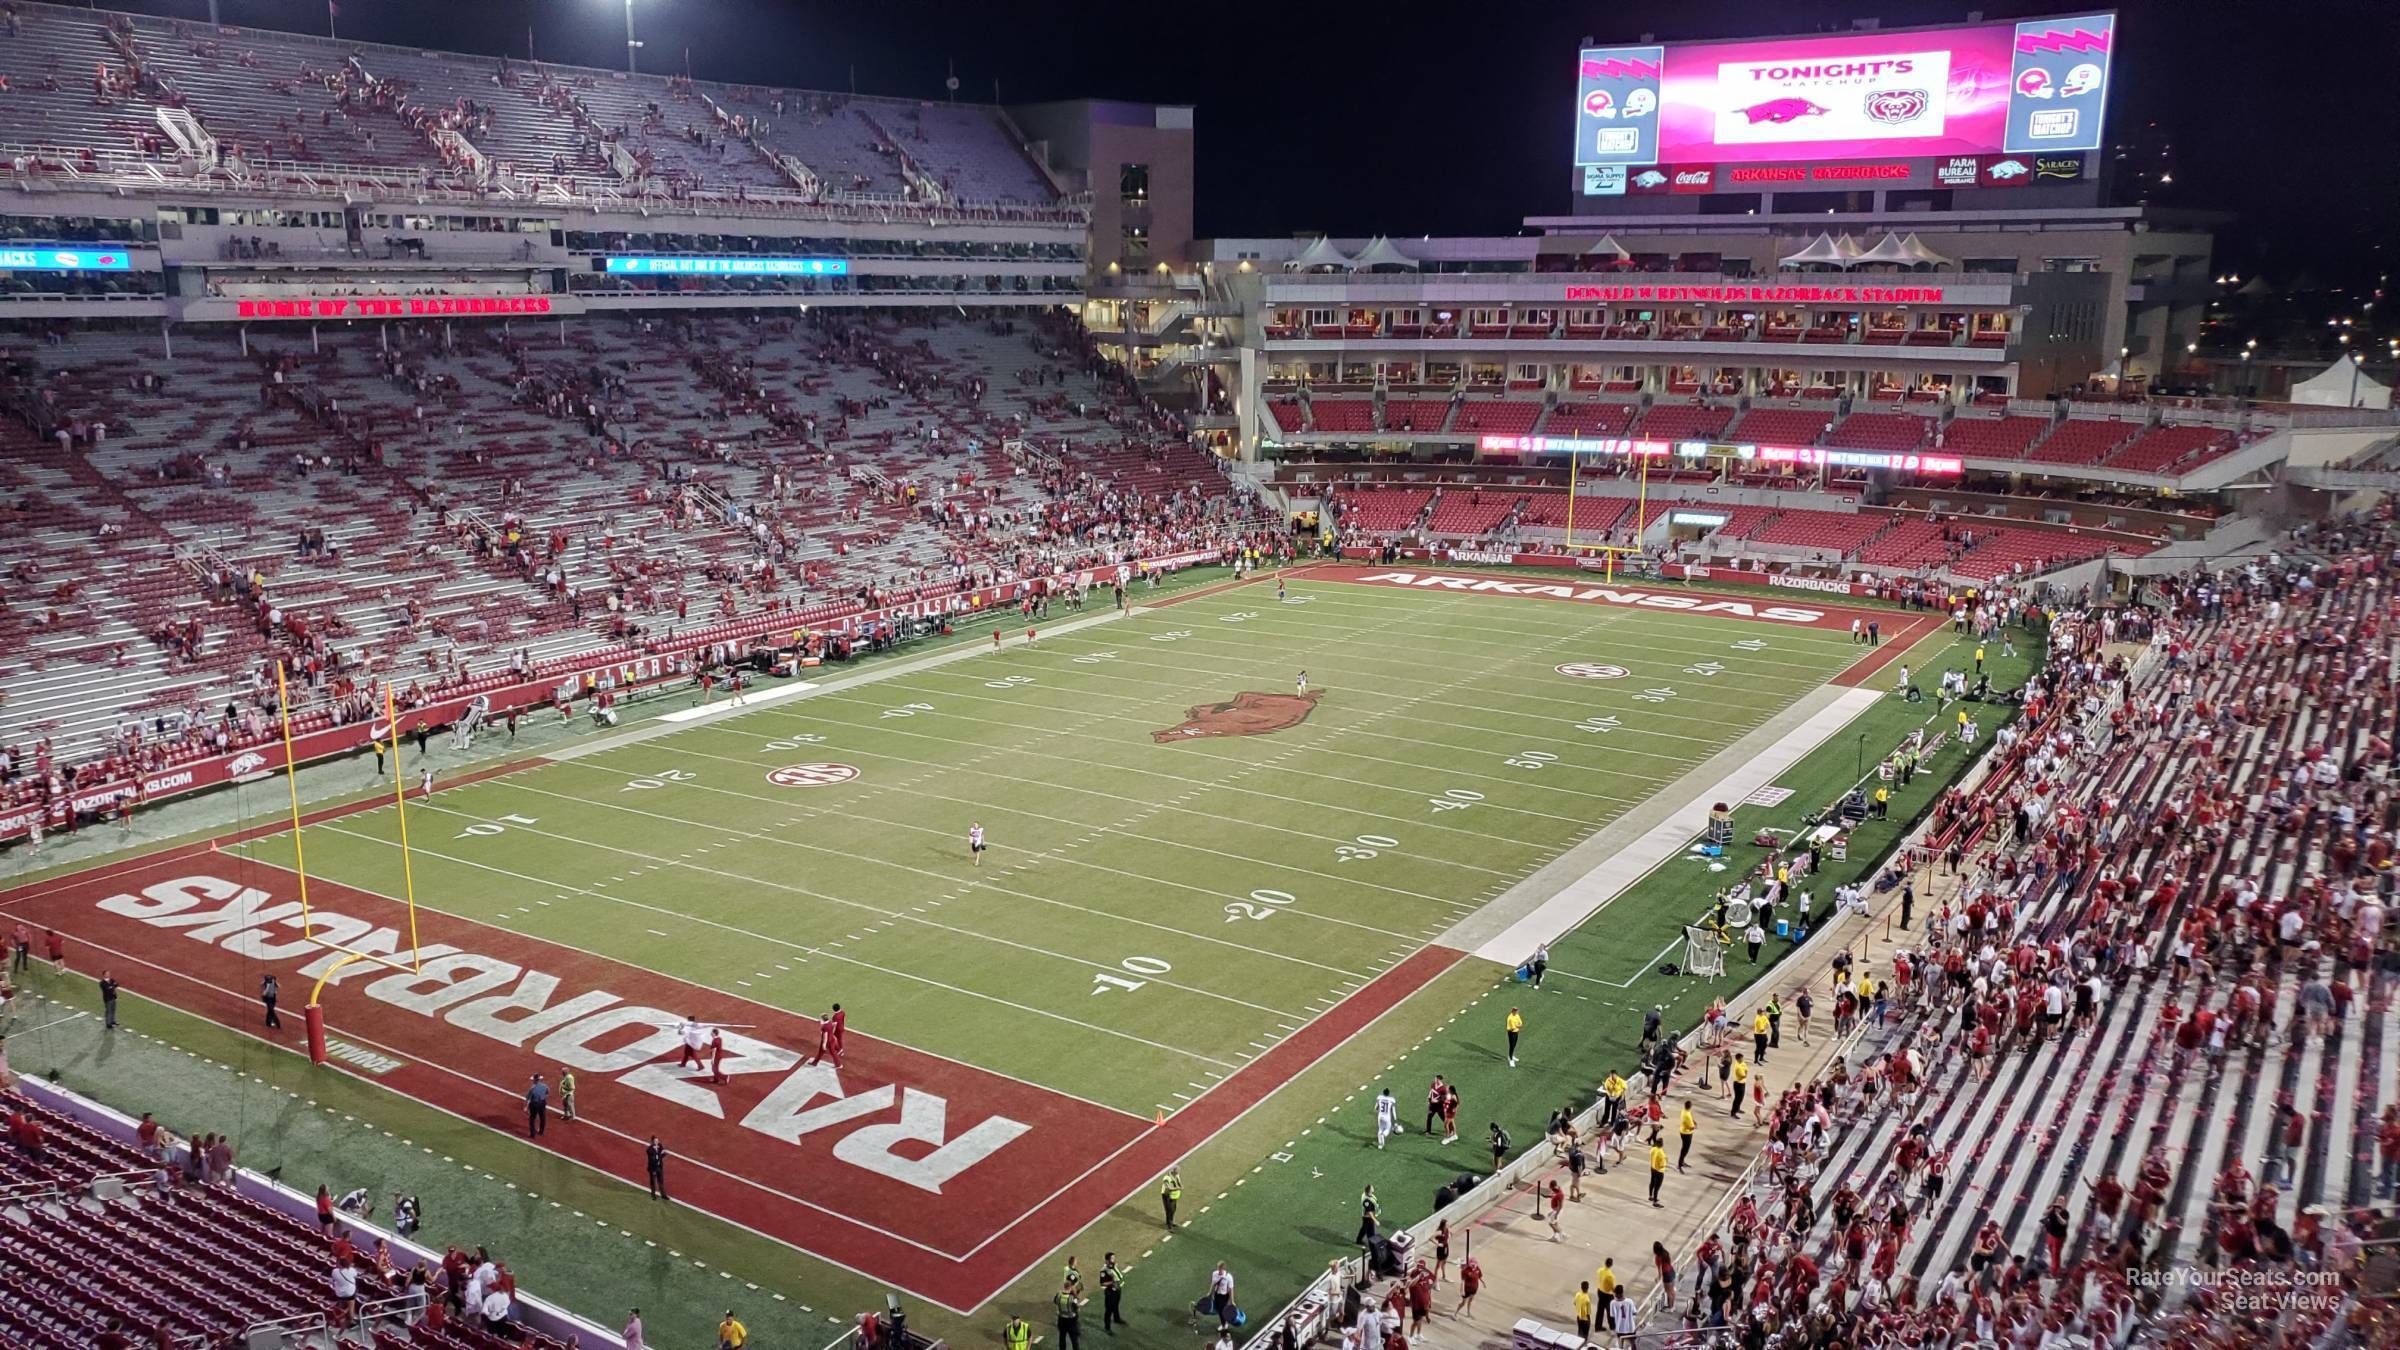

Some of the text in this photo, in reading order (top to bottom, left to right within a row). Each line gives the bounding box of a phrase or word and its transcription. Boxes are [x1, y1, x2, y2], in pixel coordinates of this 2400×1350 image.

[1749, 60, 1914, 81] TONIGHT'S
[1782, 78, 1877, 87] MATCHUP
[1938, 167, 1977, 177] BUREAU
[1950, 158, 1976, 167] FARM
[1731, 164, 1910, 183] ARKANSAS RAZORBACKS
[1566, 286, 1635, 301] DONALD
[1657, 286, 1747, 302] REYNOLDS
[1750, 286, 1859, 302] RAZORBACK
[1861, 287, 1943, 302] STADIUM
[239, 298, 551, 317] HOME OF THE RAZORBACKS
[1769, 575, 1850, 594] RAZORBACKS
[1356, 572, 1826, 622] ARKANSAS
[1730, 639, 1767, 651] 10
[1682, 662, 1725, 676] 20
[985, 675, 1036, 689] 50
[1631, 688, 1677, 702] 30
[883, 702, 935, 717] 40
[1574, 716, 1622, 733] 40
[766, 733, 827, 750] 30
[1503, 751, 1559, 770] 50
[628, 769, 696, 789] 20
[1428, 789, 1485, 811] 40
[465, 814, 540, 836] 10
[1334, 834, 1399, 859] 30
[1224, 889, 1296, 921] 20
[1092, 956, 1172, 993] 10
[95, 875, 1033, 1195] RAZORBACKS
[1380, 1101, 1389, 1113] 31
